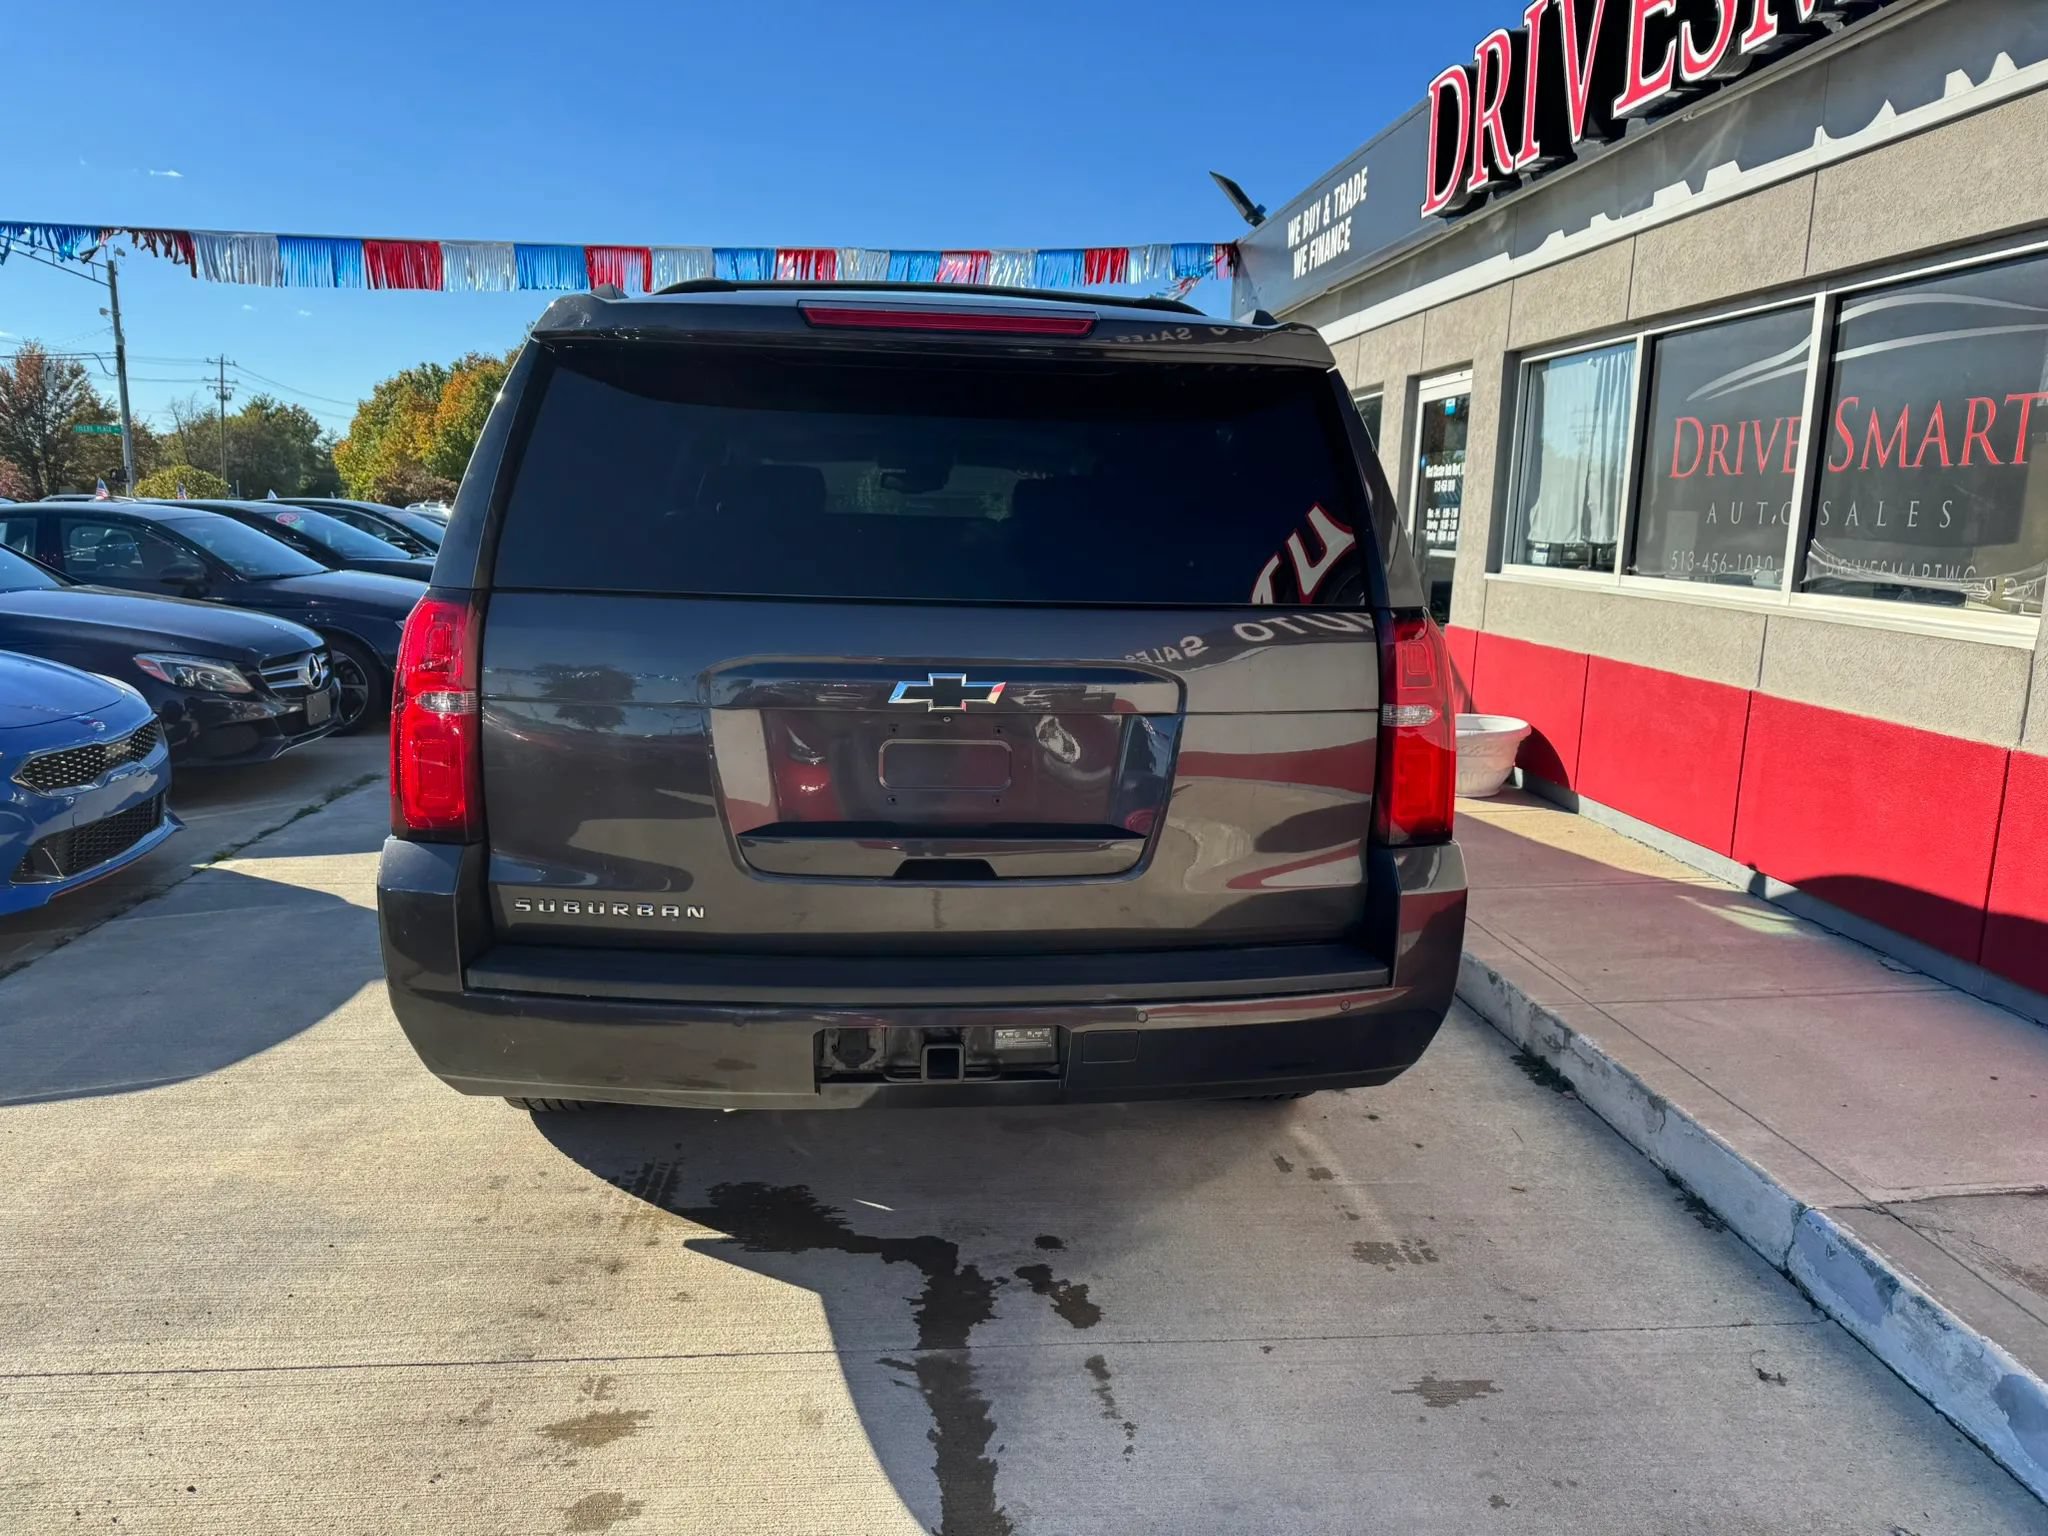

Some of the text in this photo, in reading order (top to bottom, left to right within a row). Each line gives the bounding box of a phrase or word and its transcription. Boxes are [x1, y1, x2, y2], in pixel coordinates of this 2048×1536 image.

[1287, 166, 1368, 249] WE BUY & TRADE
[1293, 216, 1351, 280] WE FINANCE
[1669, 392, 2048, 479] DRIVE SMART
[1706, 499, 1954, 528] AUTO SALES
[514, 898, 705, 919] SUBURBAN
